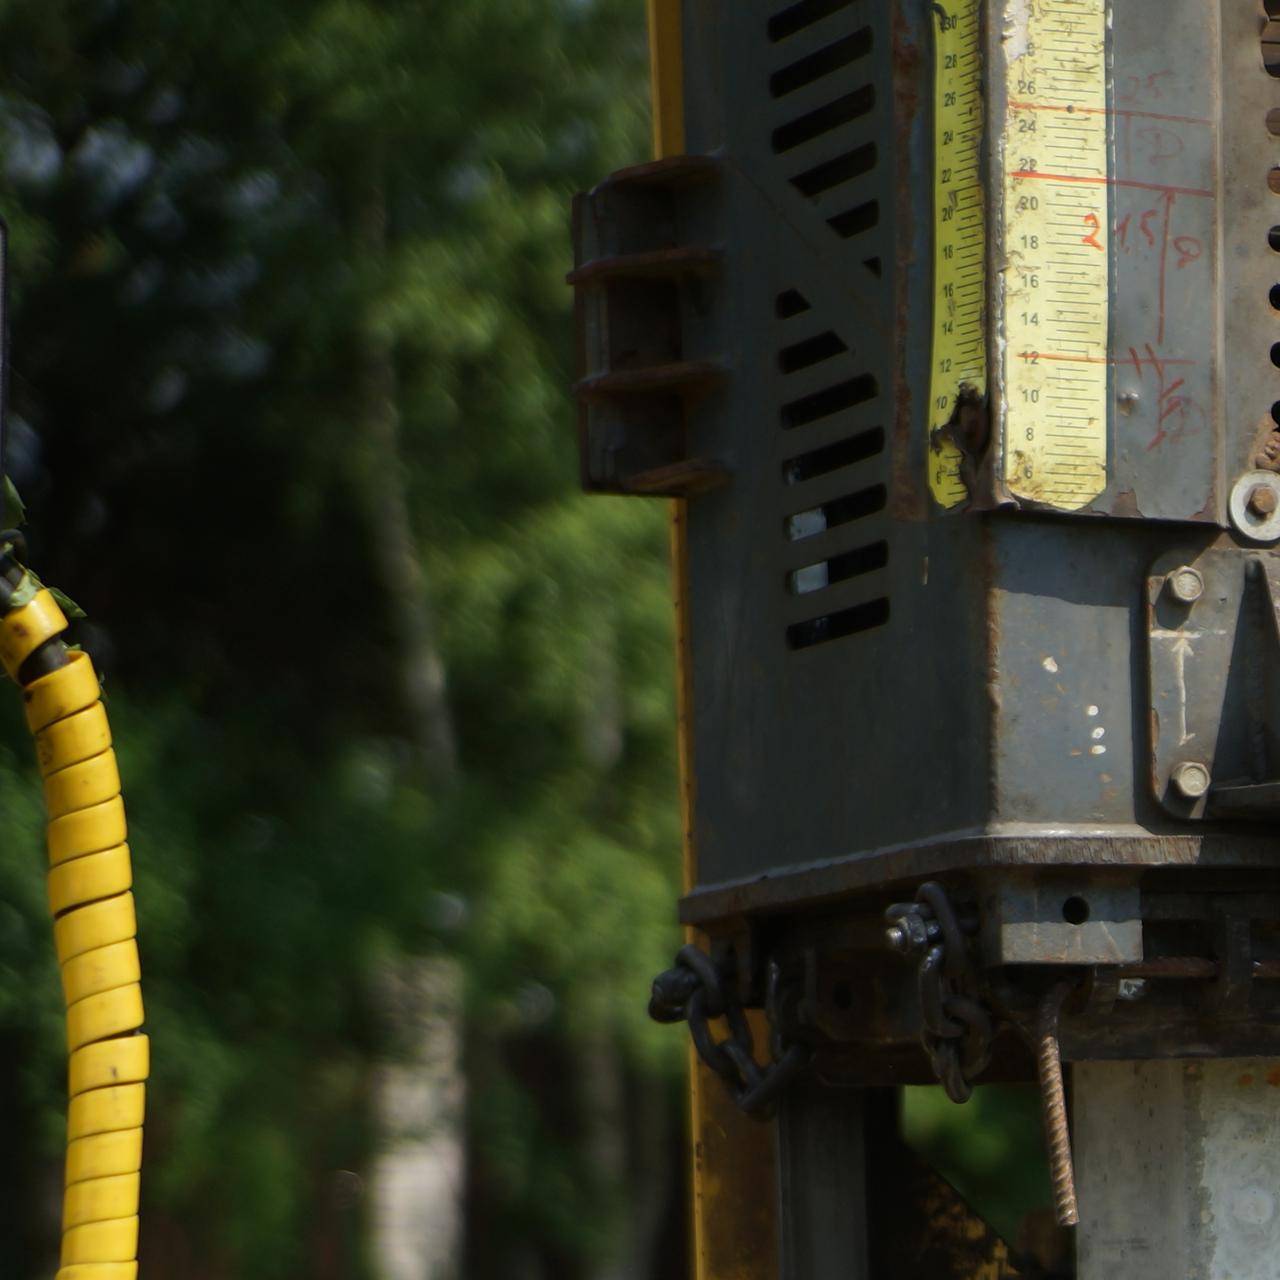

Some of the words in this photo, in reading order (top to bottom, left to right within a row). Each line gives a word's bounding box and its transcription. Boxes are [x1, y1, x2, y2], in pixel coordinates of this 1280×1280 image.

[942, 15, 957, 31] 30
[944, 54, 957, 69] 28
[1018, 80, 1036, 95] 26
[944, 92, 956, 107] 26
[1019, 119, 1037, 133] 24
[943, 130, 953, 145] 24
[1020, 158, 1037, 173] 22
[942, 168, 952, 184] 22
[1020, 196, 1039, 211] 20
[942, 206, 953, 222] 20
[1020, 235, 1039, 249] 18
[944, 245, 953, 259] 18
[1021, 274, 1039, 288] 16
[944, 283, 954, 298] 16
[1021, 312, 1039, 326] 14
[943, 321, 953, 336] 14
[1022, 350, 1039, 365] 12
[940, 358, 951, 373] 12
[936, 396, 948, 409] 10
[1022, 389, 1039, 403] 10
[1026, 427, 1034, 441] 8
